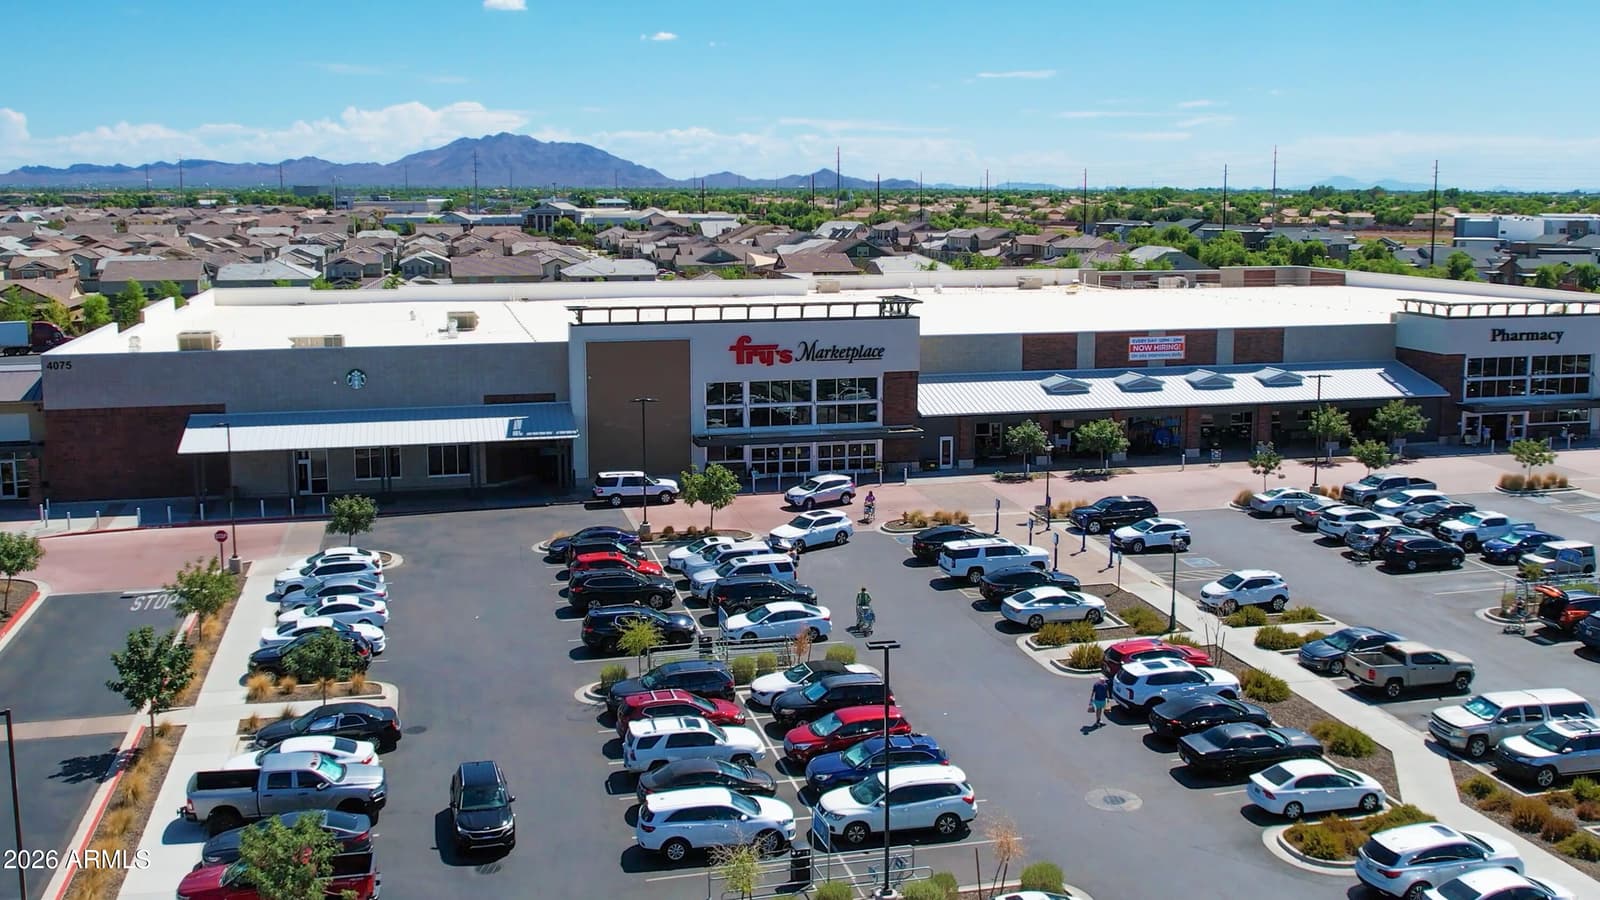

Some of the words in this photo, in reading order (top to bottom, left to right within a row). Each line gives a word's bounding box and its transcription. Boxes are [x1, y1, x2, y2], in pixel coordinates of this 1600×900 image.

[1490, 328, 1565, 344] Pharmacy
[728, 335, 793, 366] fry's
[795, 339, 886, 364] Marketplace
[1133, 344, 1152, 352] NOW
[1153, 343, 1182, 351] HIRING!
[46, 360, 72, 370] 4075
[130, 594, 180, 611] STOP
